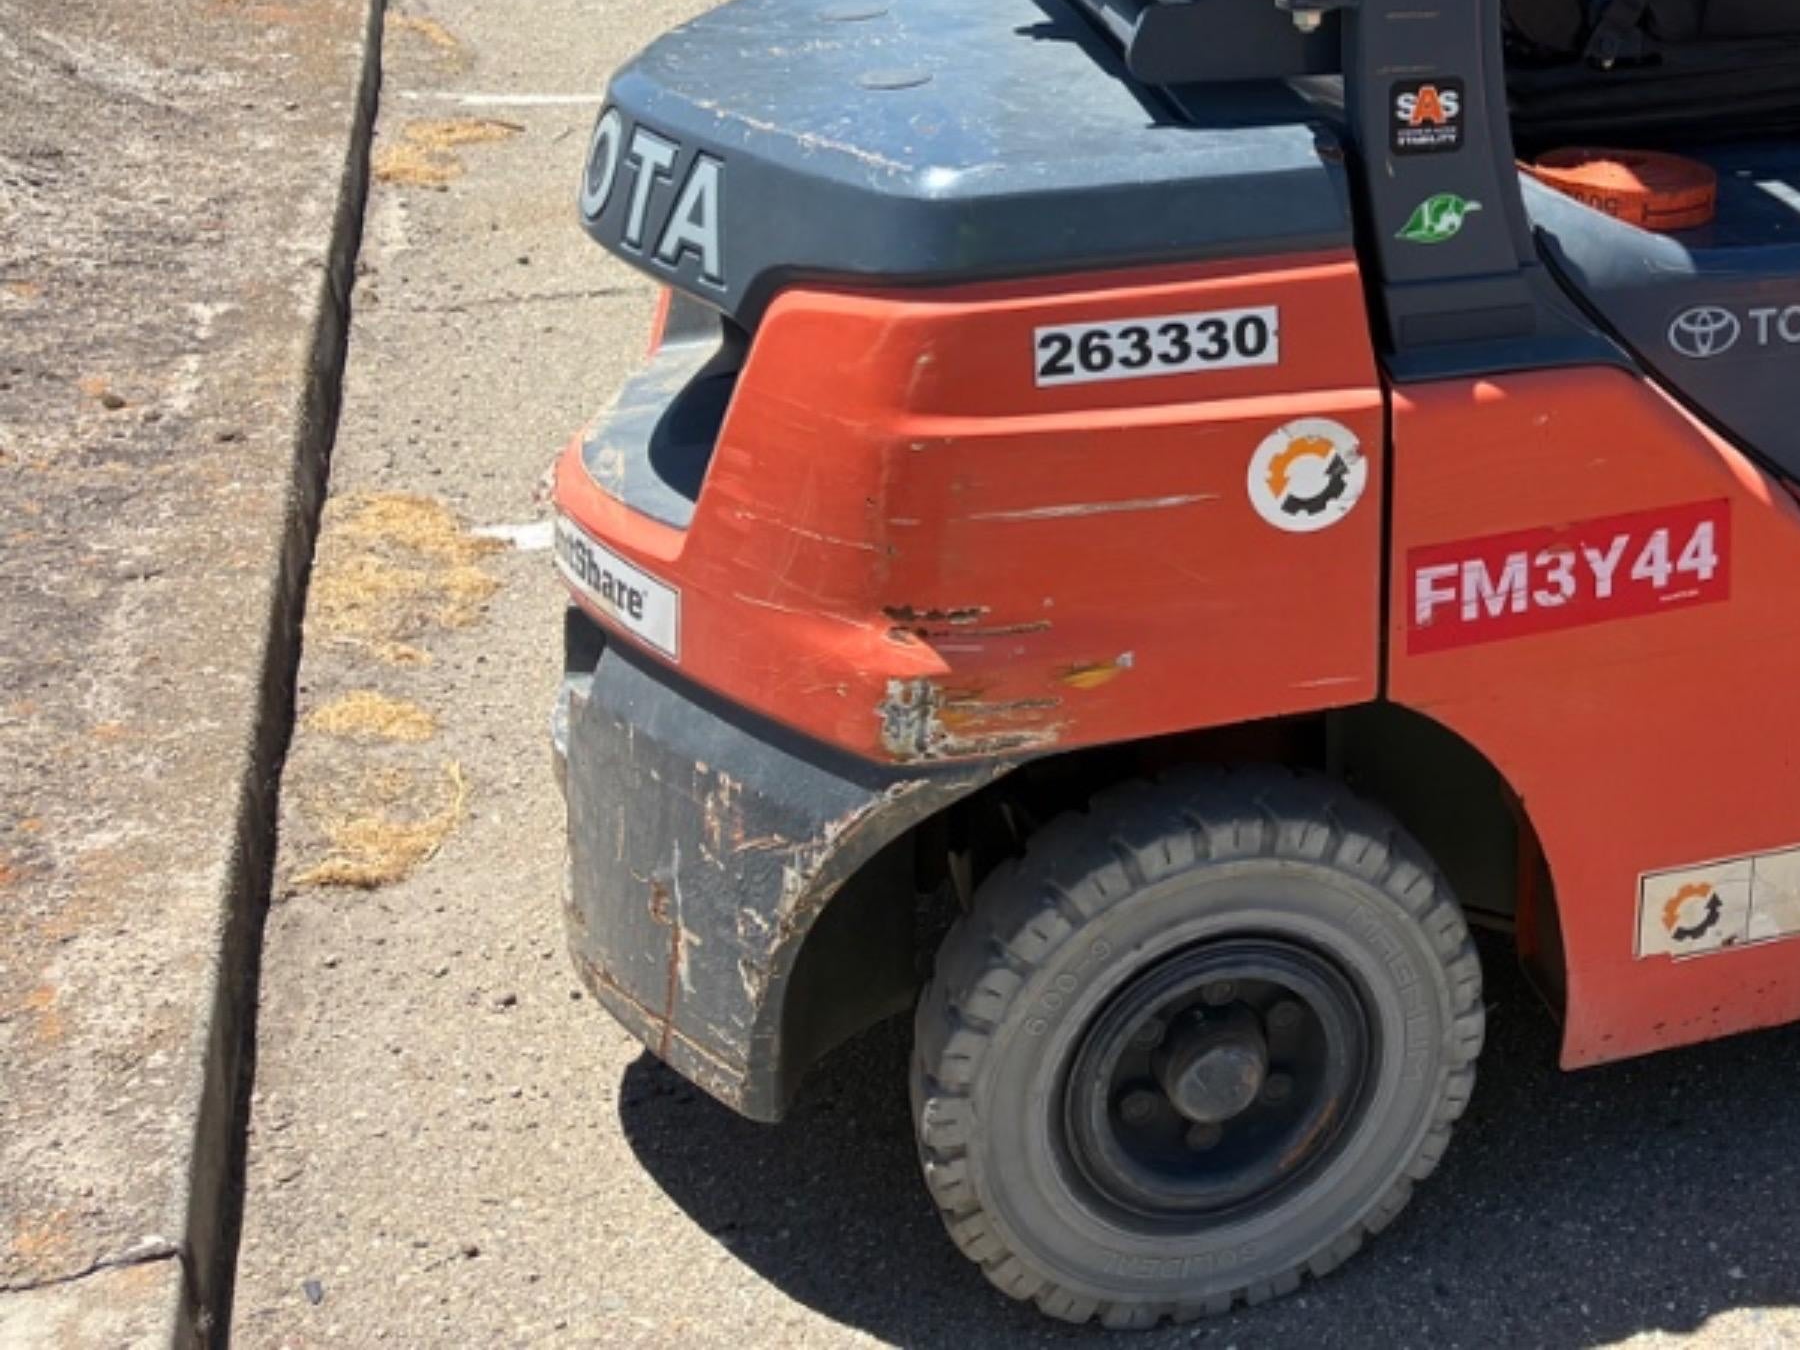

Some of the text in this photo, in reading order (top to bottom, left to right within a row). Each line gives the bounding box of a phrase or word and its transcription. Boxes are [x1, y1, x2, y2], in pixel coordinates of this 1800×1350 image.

[1396, 84, 1460, 127] SAS
[579, 106, 728, 290] OTA
[1037, 314, 1269, 378] 263330
[1414, 520, 1719, 627] FM3Y44
